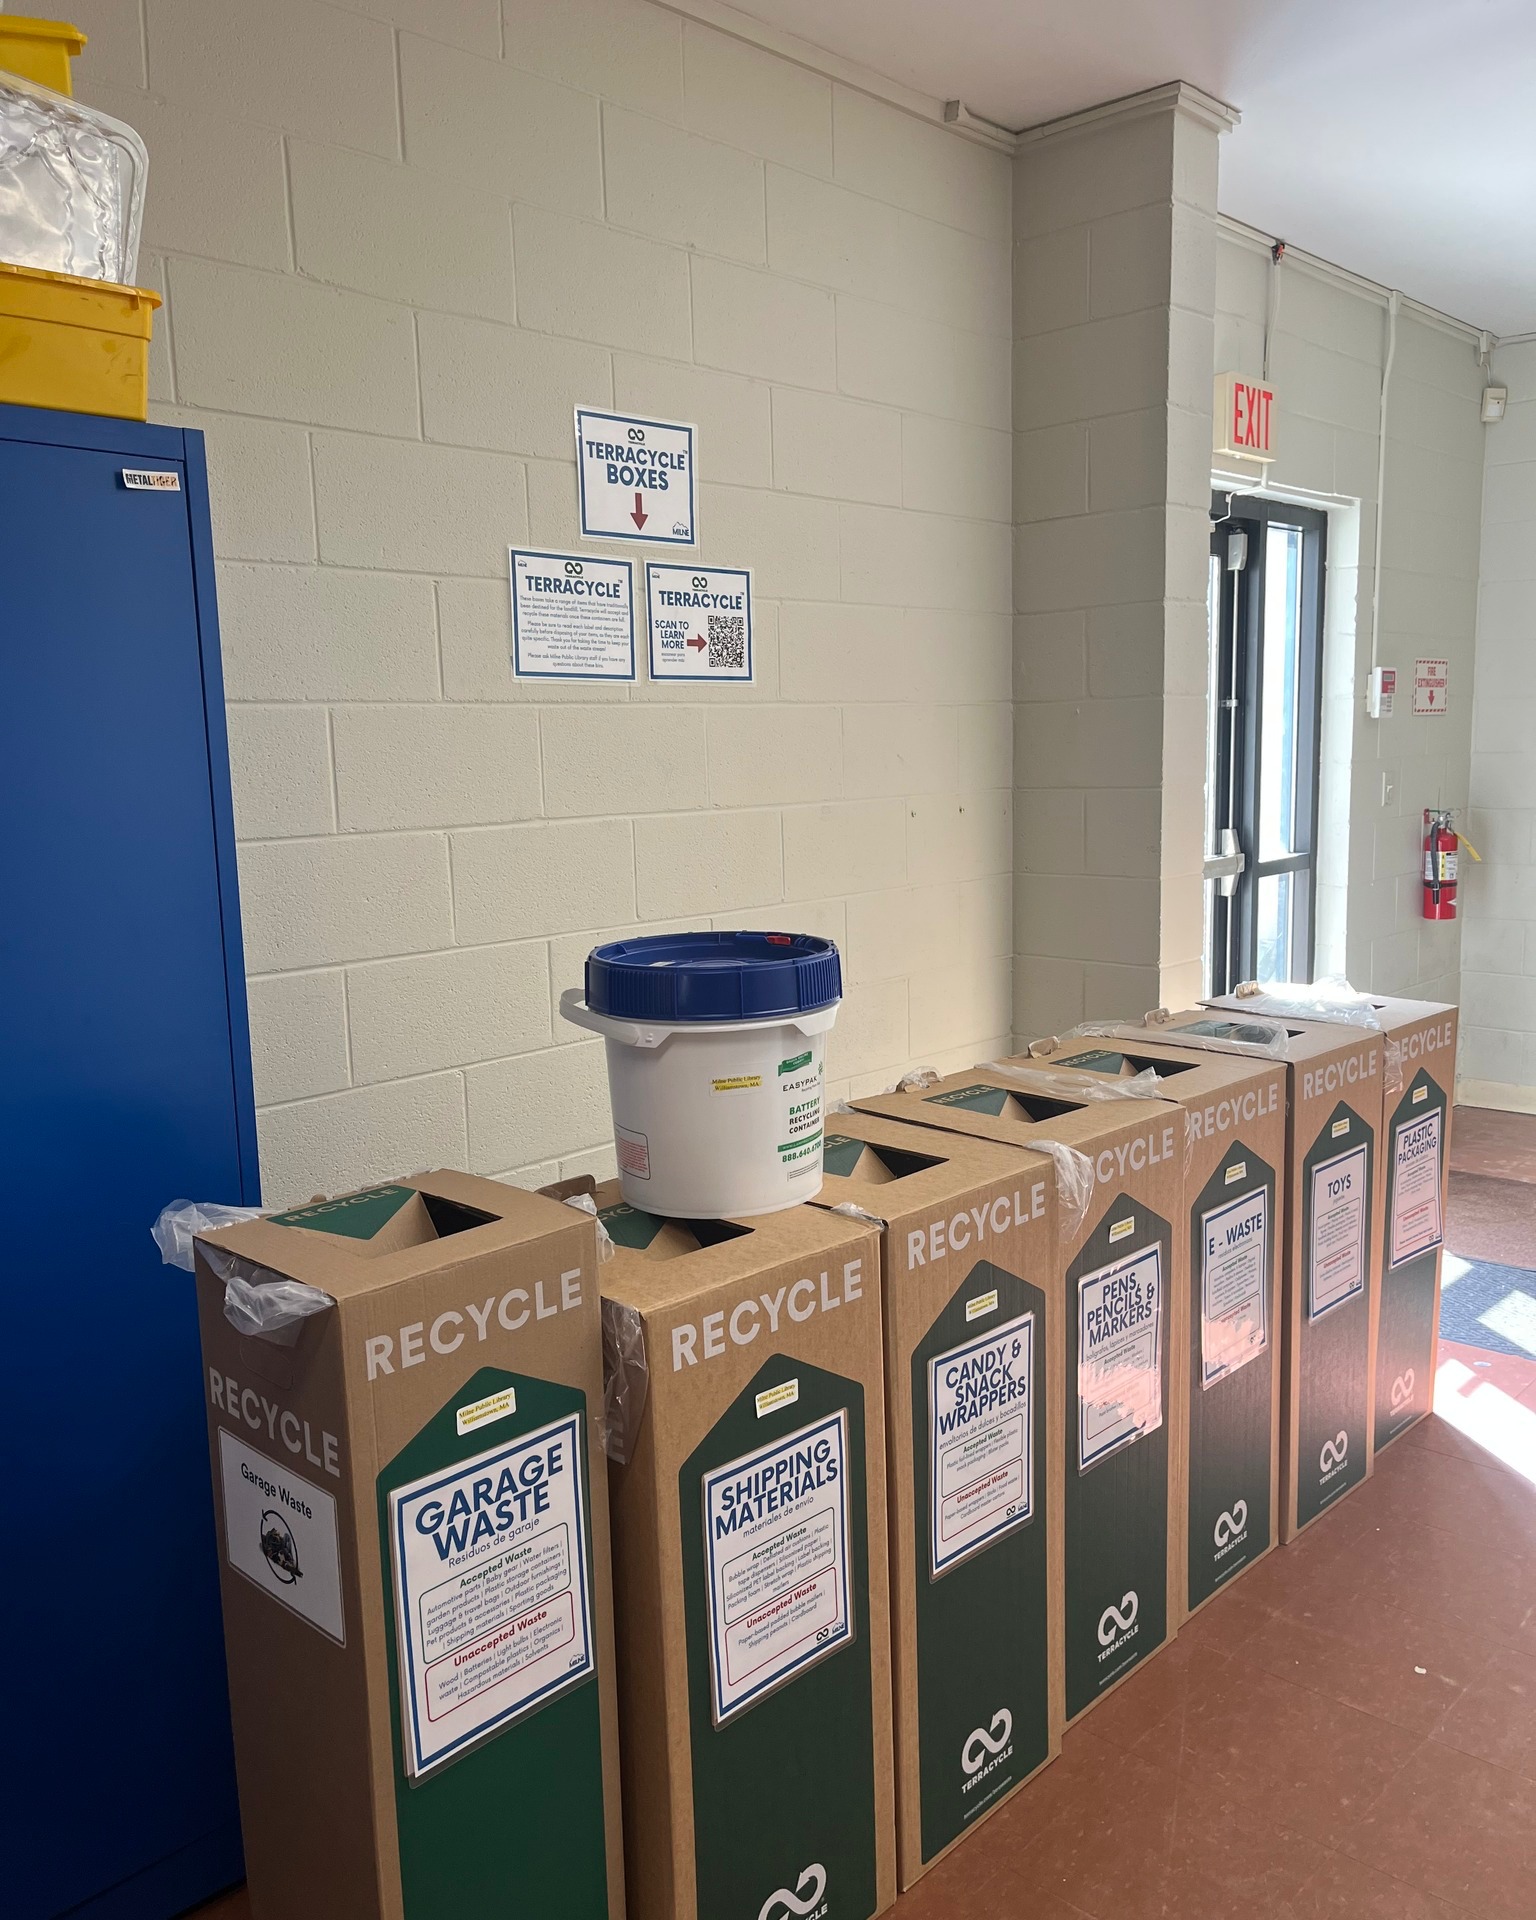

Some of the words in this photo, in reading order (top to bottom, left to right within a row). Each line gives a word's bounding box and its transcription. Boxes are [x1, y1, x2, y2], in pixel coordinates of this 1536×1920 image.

[1234, 383, 1273, 450] EXIT
[125, 474, 177, 487] METALTIGER
[607, 463, 668, 490] BOXES
[655, 620, 677, 629] SCAN
[679, 621, 689, 630] TO
[661, 630, 684, 639] LEARN
[662, 641, 684, 649] MORE
[783, 1076, 817, 1092] EASYPAK
[933, 1086, 996, 1103] RECYCLE
[1304, 1050, 1377, 1100] RECYCLE
[789, 1107, 820, 1125] RECYCLING
[789, 1117, 819, 1134] CONTAINER
[790, 1096, 820, 1115] BATTERY
[1190, 1083, 1278, 1141] RECYCLE
[1398, 1136, 1436, 1165] PACKAGING
[1403, 1123, 1432, 1149] PLASTIC
[284, 1188, 399, 1221] RECYCLE
[1328, 1174, 1351, 1197] TOYS
[907, 1181, 1046, 1270] RECYCLE
[1209, 1237, 1214, 1255] E
[1226, 1212, 1261, 1245] WASTE
[1087, 1288, 1142, 1329] PENCILS
[1147, 1282, 1154, 1300] &
[1103, 1272, 1139, 1303] PENS,
[366, 1268, 582, 1381] RECYCLE
[671, 1259, 863, 1372] RECYCLE
[1089, 1301, 1151, 1347] MARKERS
[946, 1344, 1006, 1388] CANDY
[1012, 1338, 1021, 1358] &
[955, 1361, 1012, 1406] SNACK
[209, 1366, 341, 1478] RECYCLE
[939, 1376, 1025, 1434] WRAPPERS
[963, 1435, 986, 1453] Accepted
[988, 1429, 1002, 1440] Waste
[970, 1425, 976, 1434] de
[241, 1462, 276, 1497] Garage
[278, 1485, 312, 1519] Waste
[416, 1443, 562, 1535] GARAGE
[722, 1439, 830, 1510] SHIPPING
[957, 1479, 990, 1503] Unaccepted
[992, 1471, 1007, 1484] Waste
[433, 1480, 549, 1560] WASTE
[716, 1459, 837, 1539] MATERIALS
[449, 1542, 490, 1568] Residuos
[493, 1534, 505, 1546] de
[508, 1518, 539, 1540] garaje
[743, 1513, 781, 1538] materiales
[783, 1507, 793, 1516] de
[752, 1536, 784, 1561] Accepted
[786, 1527, 806, 1542] Waste
[460, 1559, 502, 1588] Accepted
[505, 1547, 531, 1564] Waste
[1214, 1530, 1247, 1562] TERRACYCLE
[426, 1610, 450, 1628] garden
[452, 1595, 479, 1615] products
[485, 1581, 504, 1595] Plastic
[506, 1569, 528, 1584] storage
[530, 1552, 560, 1571] containers
[427, 1593, 462, 1615] Automotive
[464, 1584, 480, 1598] parts
[486, 1573, 501, 1585] Baby
[503, 1564, 518, 1577] gear
[523, 1552, 541, 1565] Water
[543, 1544, 559, 1555] filters
[428, 1617, 456, 1636] Luggage
[464, 1601, 482, 1616] travel
[484, 1594, 499, 1606] bags
[505, 1578, 529, 1594] Outdoor
[531, 1562, 560, 1580] furnishings
[426, 1637, 436, 1647] Pet
[439, 1622, 466, 1642] products
[474, 1599, 509, 1621] accessories
[515, 1586, 533, 1599] Plastic
[536, 1568, 566, 1590] packaging
[447, 1628, 474, 1646] Shipping
[476, 1612, 504, 1630] materials
[509, 1595, 534, 1612] Sporting
[536, 1585, 553, 1600] goods
[747, 1595, 792, 1628] Unaccepted
[794, 1584, 816, 1600] Waste
[439, 1673, 458, 1689] Wood
[464, 1656, 492, 1676] Batteries
[497, 1644, 511, 1657] Light
[513, 1636, 528, 1648] bulbs
[533, 1617, 561, 1636] Electronic
[454, 1625, 514, 1666] Unaccepted
[517, 1611, 546, 1631] Waste
[1097, 1625, 1139, 1663] TERRACYCLE
[439, 1686, 458, 1700] waste
[463, 1659, 504, 1686] Compostable
[506, 1645, 528, 1663] plastics
[533, 1628, 560, 1645] Organics
[458, 1677, 490, 1700] Hazardous
[492, 1660, 520, 1679] materials
[525, 1644, 548, 1660] Solvents
[961, 1745, 1013, 1794] TERRACYCLE
